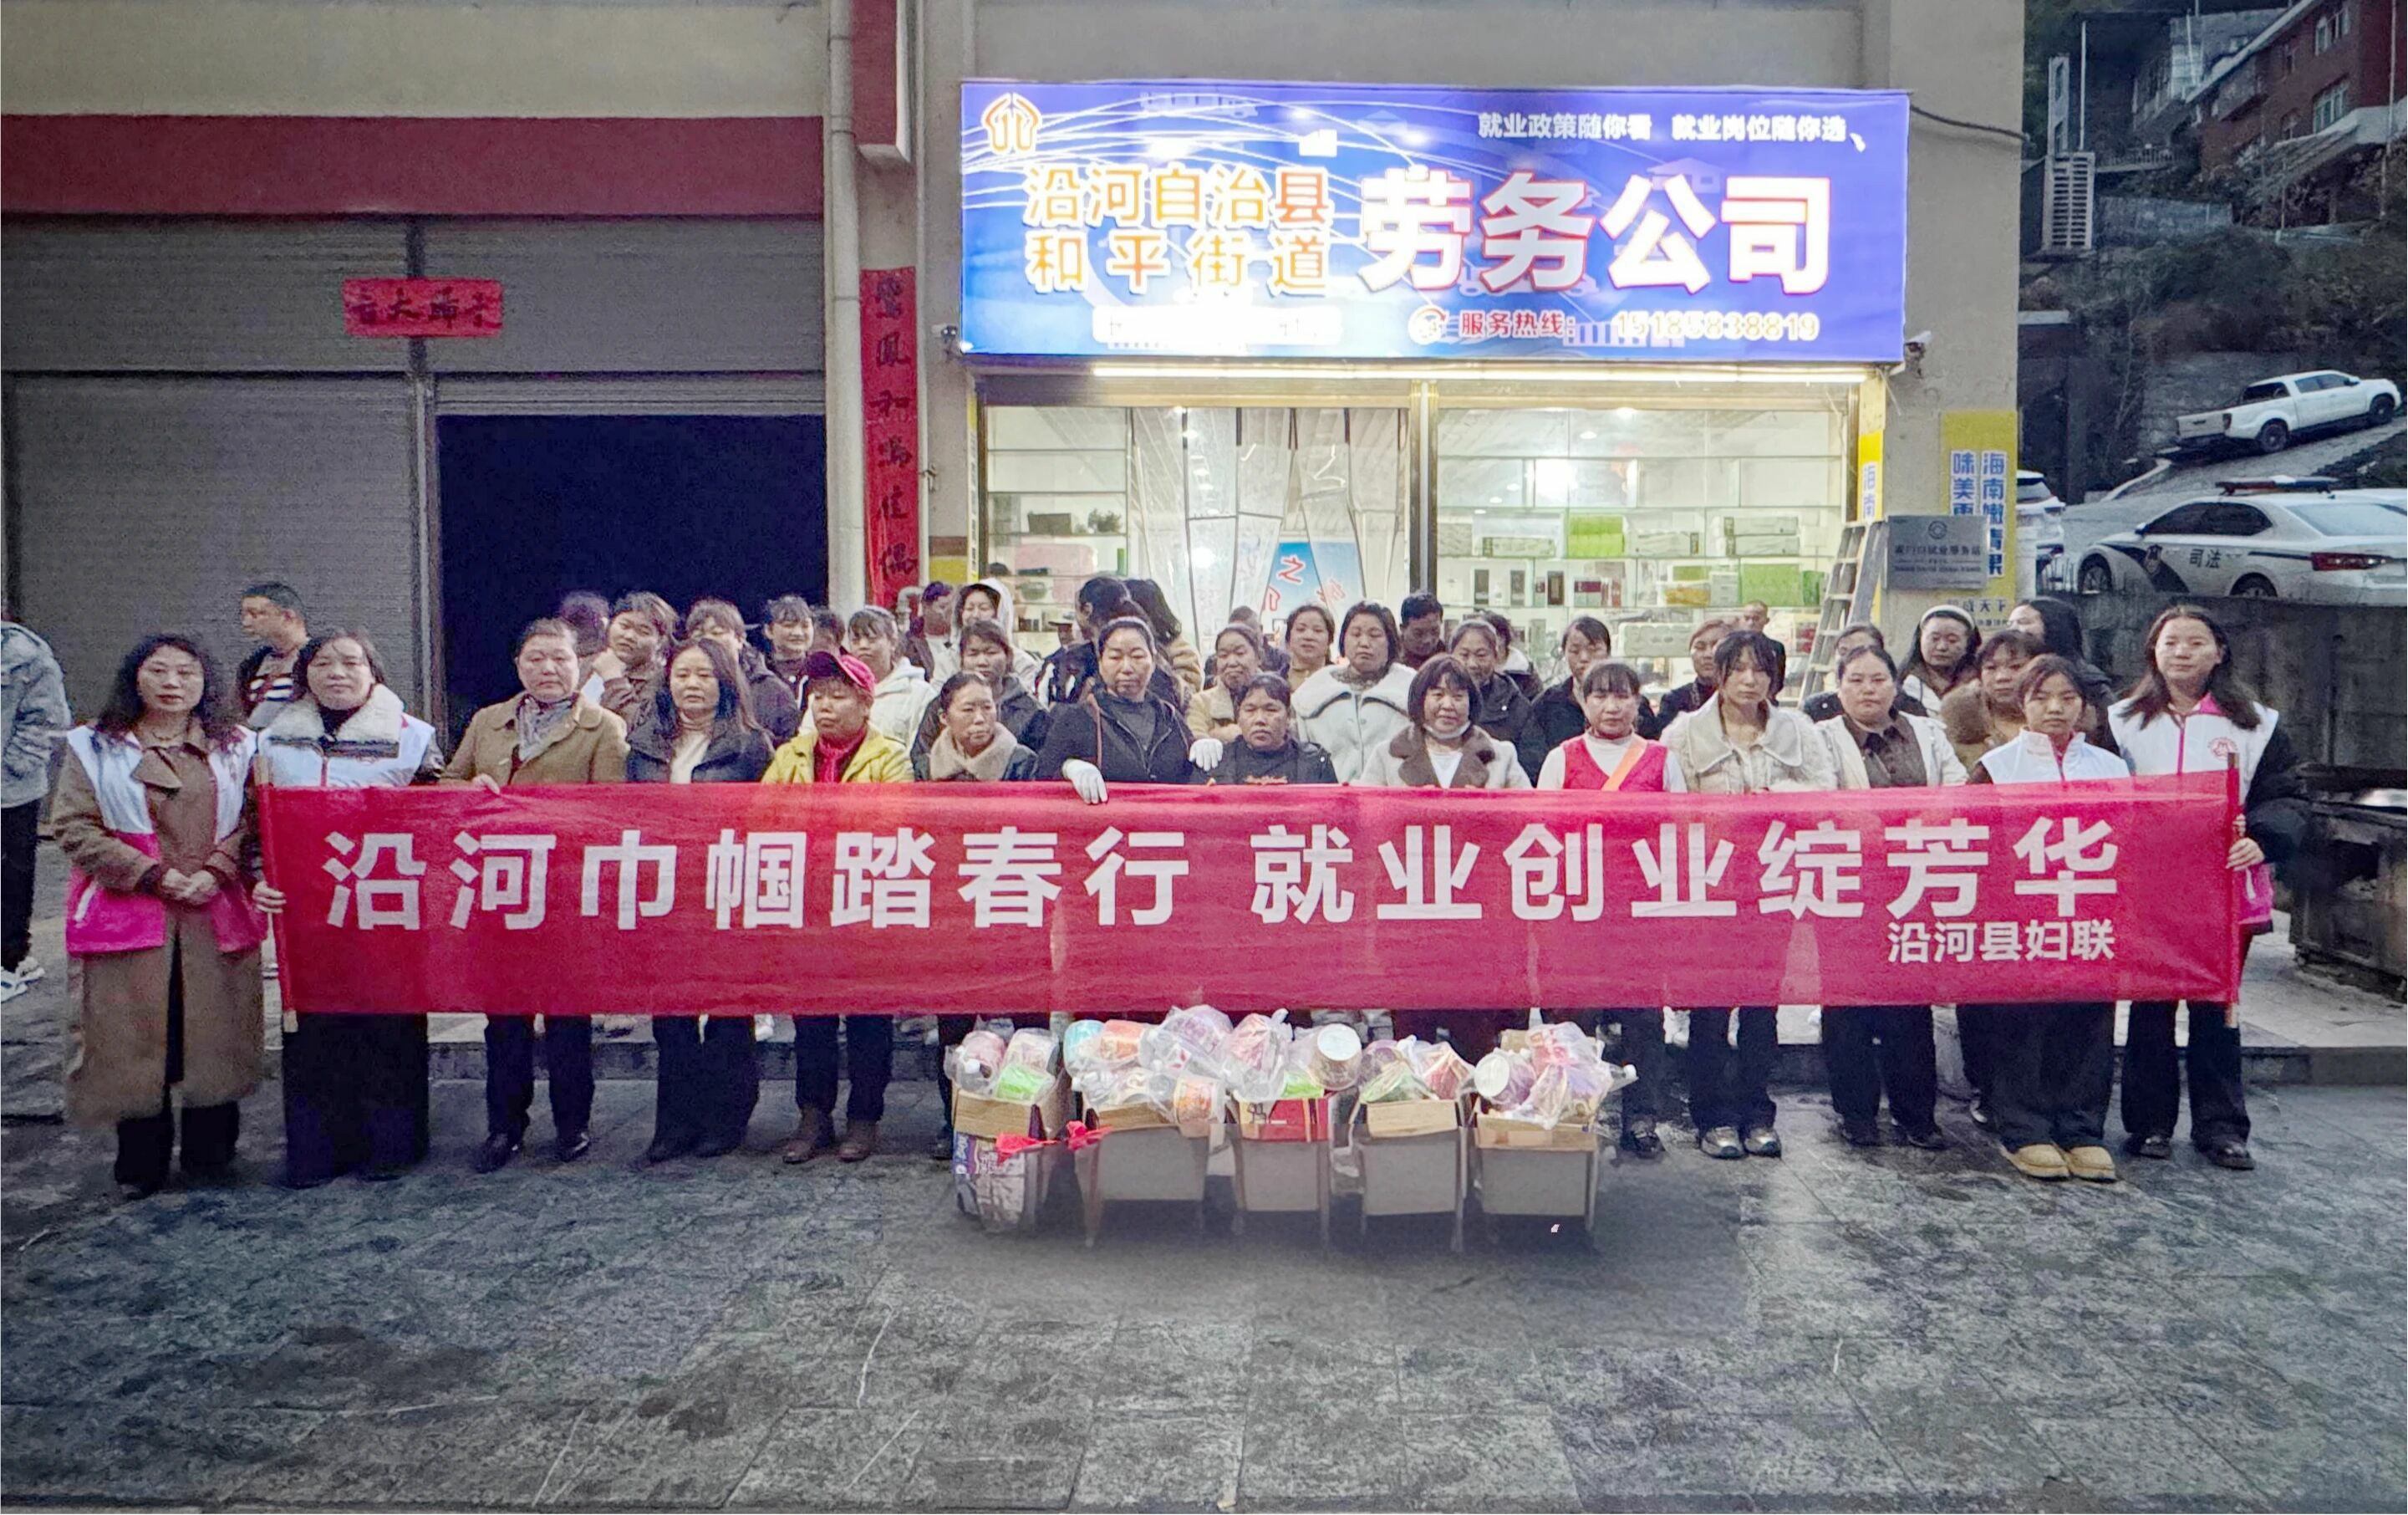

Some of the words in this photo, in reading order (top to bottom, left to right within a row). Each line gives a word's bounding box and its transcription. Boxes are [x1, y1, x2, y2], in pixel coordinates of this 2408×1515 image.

[1479, 112, 1652, 140] 就业政策随你看
[1671, 114, 1846, 142] 就业岗位随你选
[1022, 162, 1335, 228] 沿河自治县
[1359, 164, 1830, 294] 劳务公司
[1025, 230, 1327, 294] 和平街道
[2189, 548, 2222, 569] 司法
[323, 826, 1190, 931] 沿河巾帼踏春行
[1250, 815, 2119, 924] 就业创业绽芳华
[1886, 919, 2115, 964] 沿河县妇联
